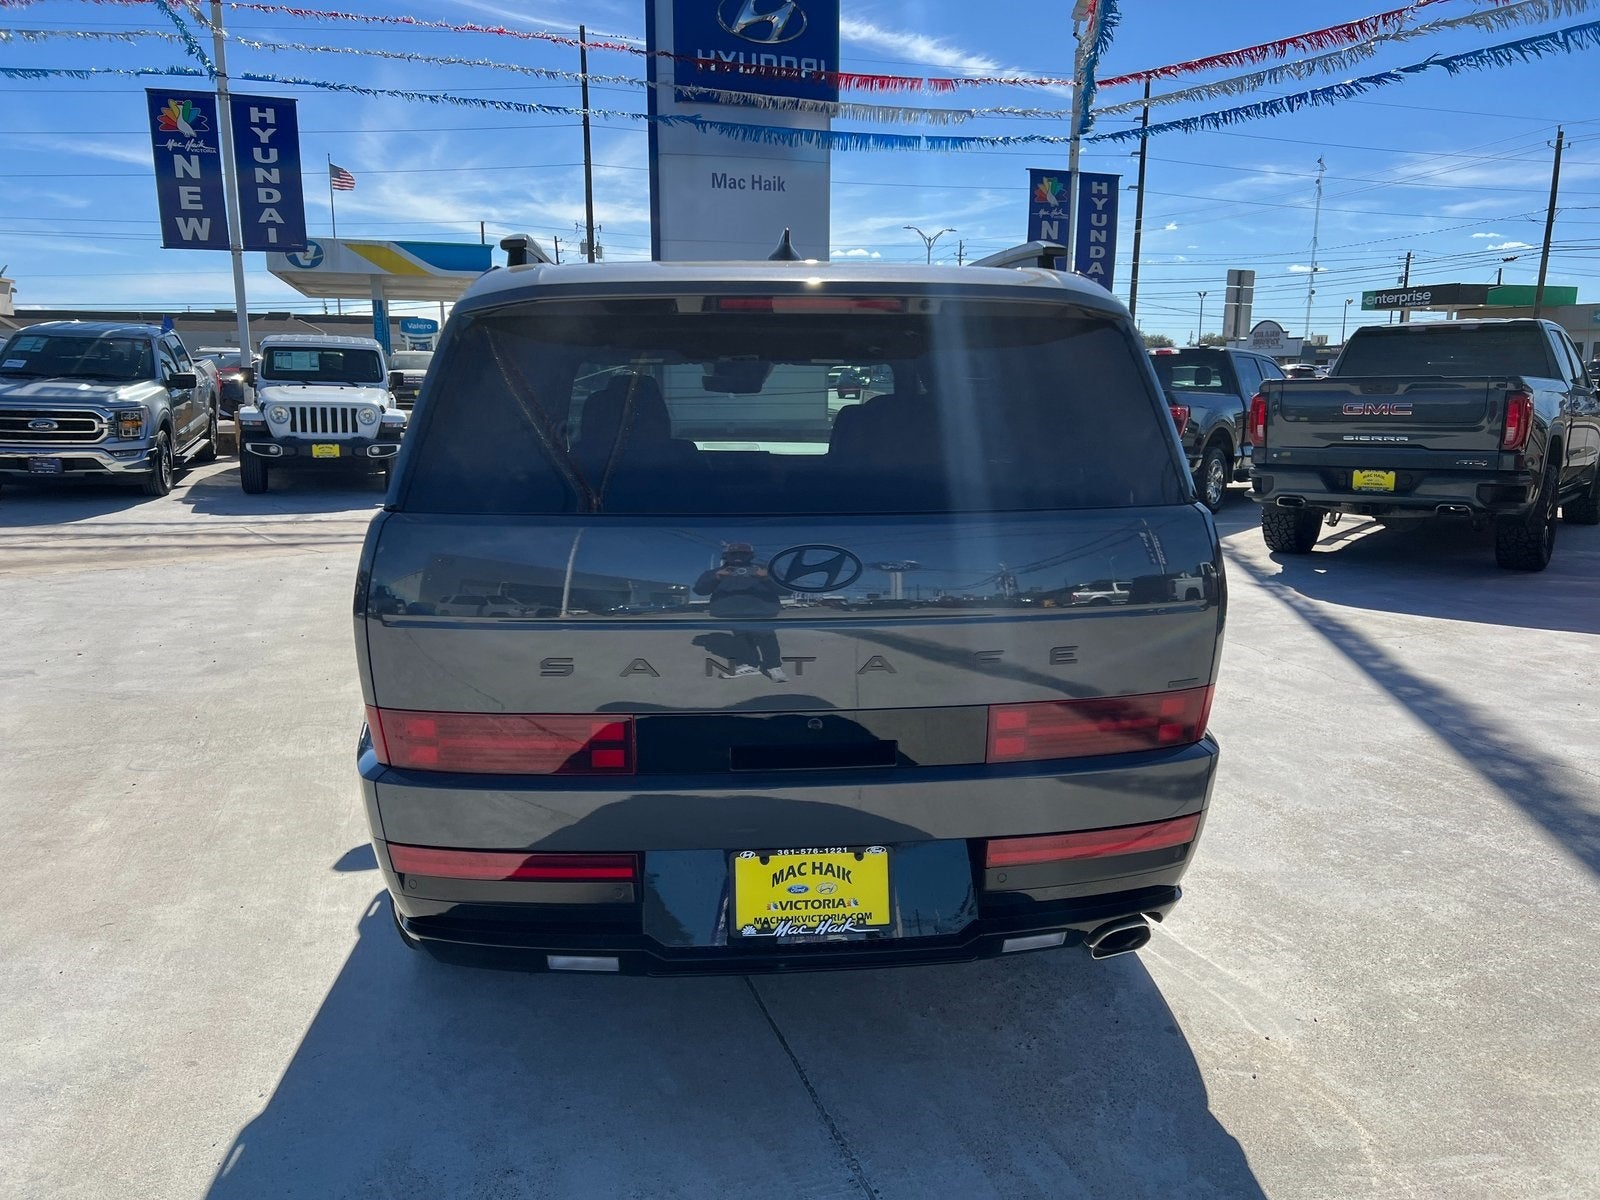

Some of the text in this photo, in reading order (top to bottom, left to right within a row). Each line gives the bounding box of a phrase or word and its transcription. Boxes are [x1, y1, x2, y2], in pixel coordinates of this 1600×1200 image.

[250, 107, 285, 243] HYUNDAI
[711, 172, 786, 192] Mac Haik
[173, 154, 211, 241] NEW
[1365, 290, 1432, 306] enterprise
[407, 322, 432, 330] Valero
[1343, 403, 1413, 416] GMC
[539, 645, 1079, 678] SANTA FE
[777, 847, 848, 855] 361-576-1221
[771, 861, 853, 888] MAC HAIK
[778, 898, 847, 911] VICTORIA
[753, 912, 873, 925] MACHAIKVICTORIACOM
[774, 917, 860, 937] Mac Haik
